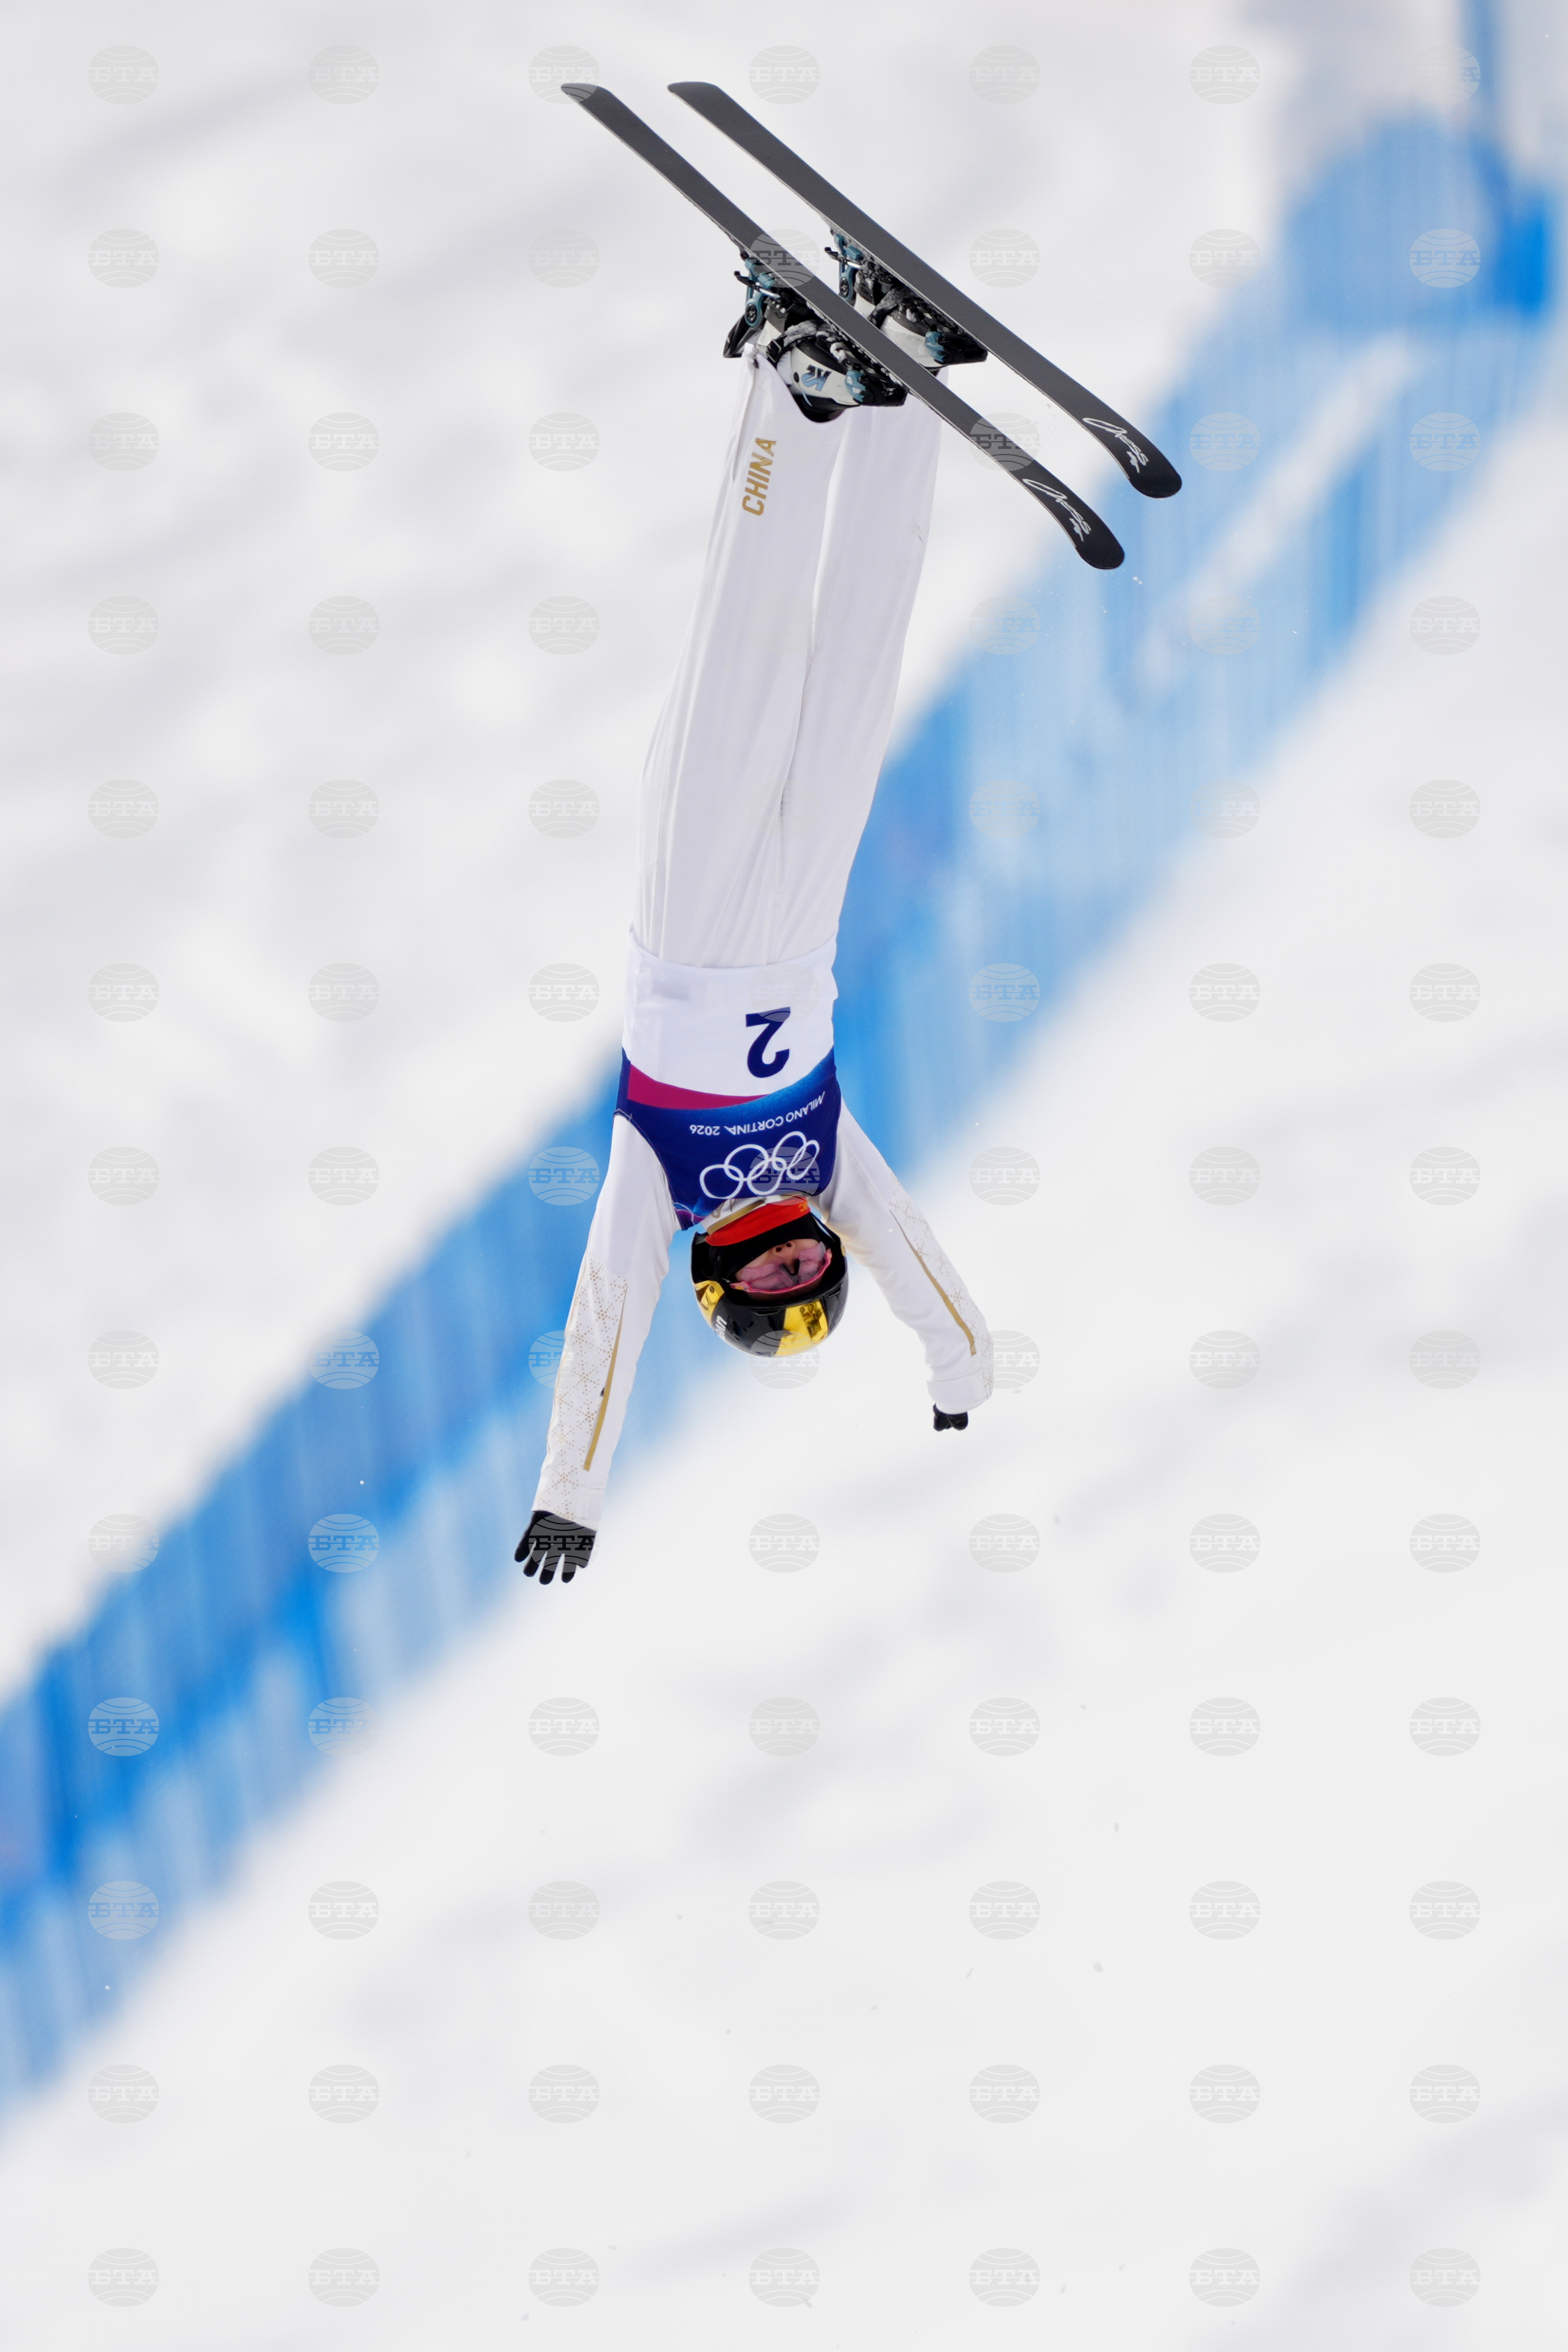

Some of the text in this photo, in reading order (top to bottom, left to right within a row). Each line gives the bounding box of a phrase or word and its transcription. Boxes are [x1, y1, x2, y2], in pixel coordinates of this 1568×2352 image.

[741, 437, 776, 516] CHINA
[745, 1007, 790, 1078] 2
[689, 1090, 825, 1136] MILANO CORTINA 2026
